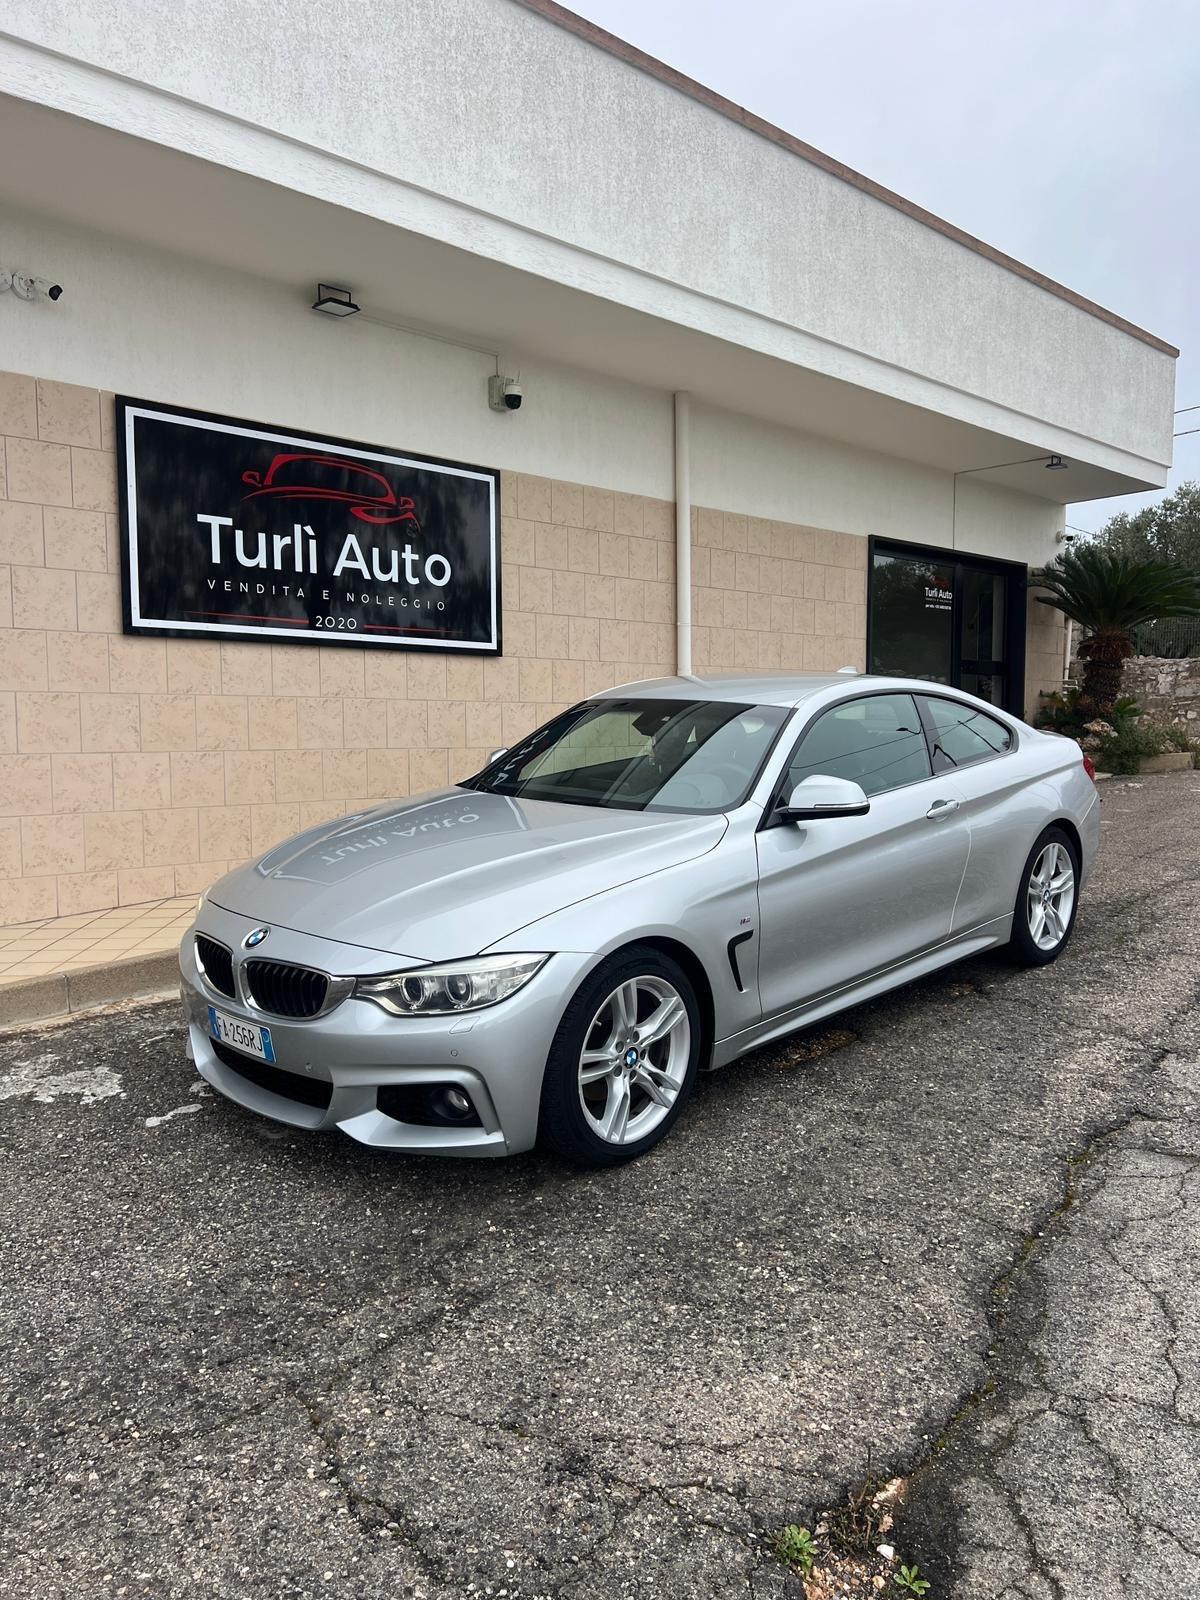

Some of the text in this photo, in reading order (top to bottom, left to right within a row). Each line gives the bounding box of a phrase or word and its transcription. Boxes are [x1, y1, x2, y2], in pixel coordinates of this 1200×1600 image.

[196, 513, 451, 587] Turlì Auto
[207, 578, 446, 611] VENDITA E NOLEGGIO
[315, 615, 357, 630] 2020
